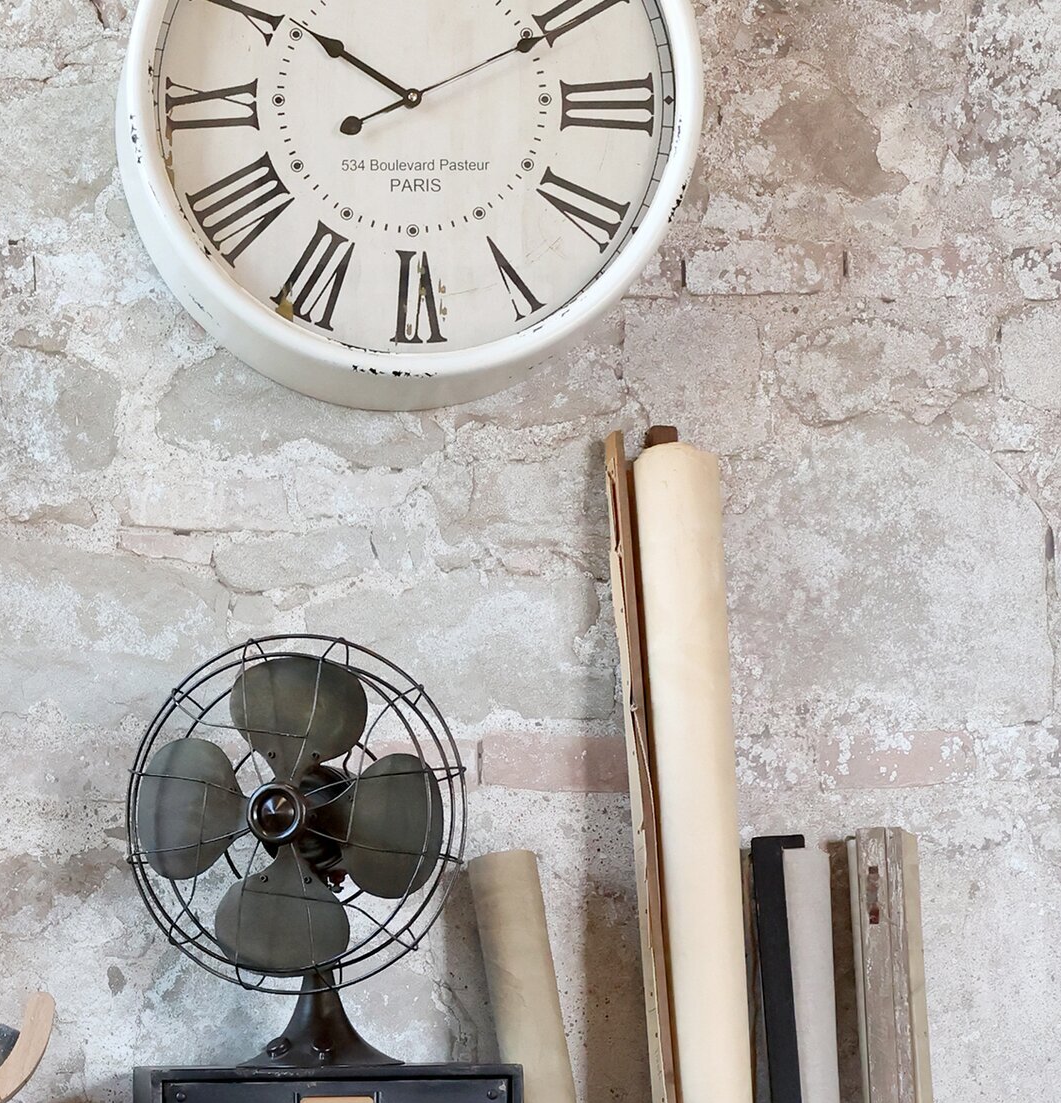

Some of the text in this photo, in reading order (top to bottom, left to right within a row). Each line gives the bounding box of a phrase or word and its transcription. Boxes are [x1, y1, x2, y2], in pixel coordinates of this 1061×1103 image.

[166, 77, 260, 130] IX
[559, 72, 655, 137] III
[341, 159, 490, 172] 534 Boulevard Pasteur
[390, 178, 441, 192] PARIS
[185, 151, 295, 268] VIII
[536, 166, 631, 254] IV
[269, 219, 355, 331] VII
[390, 250, 448, 343] VI
[486, 235, 547, 322] V
